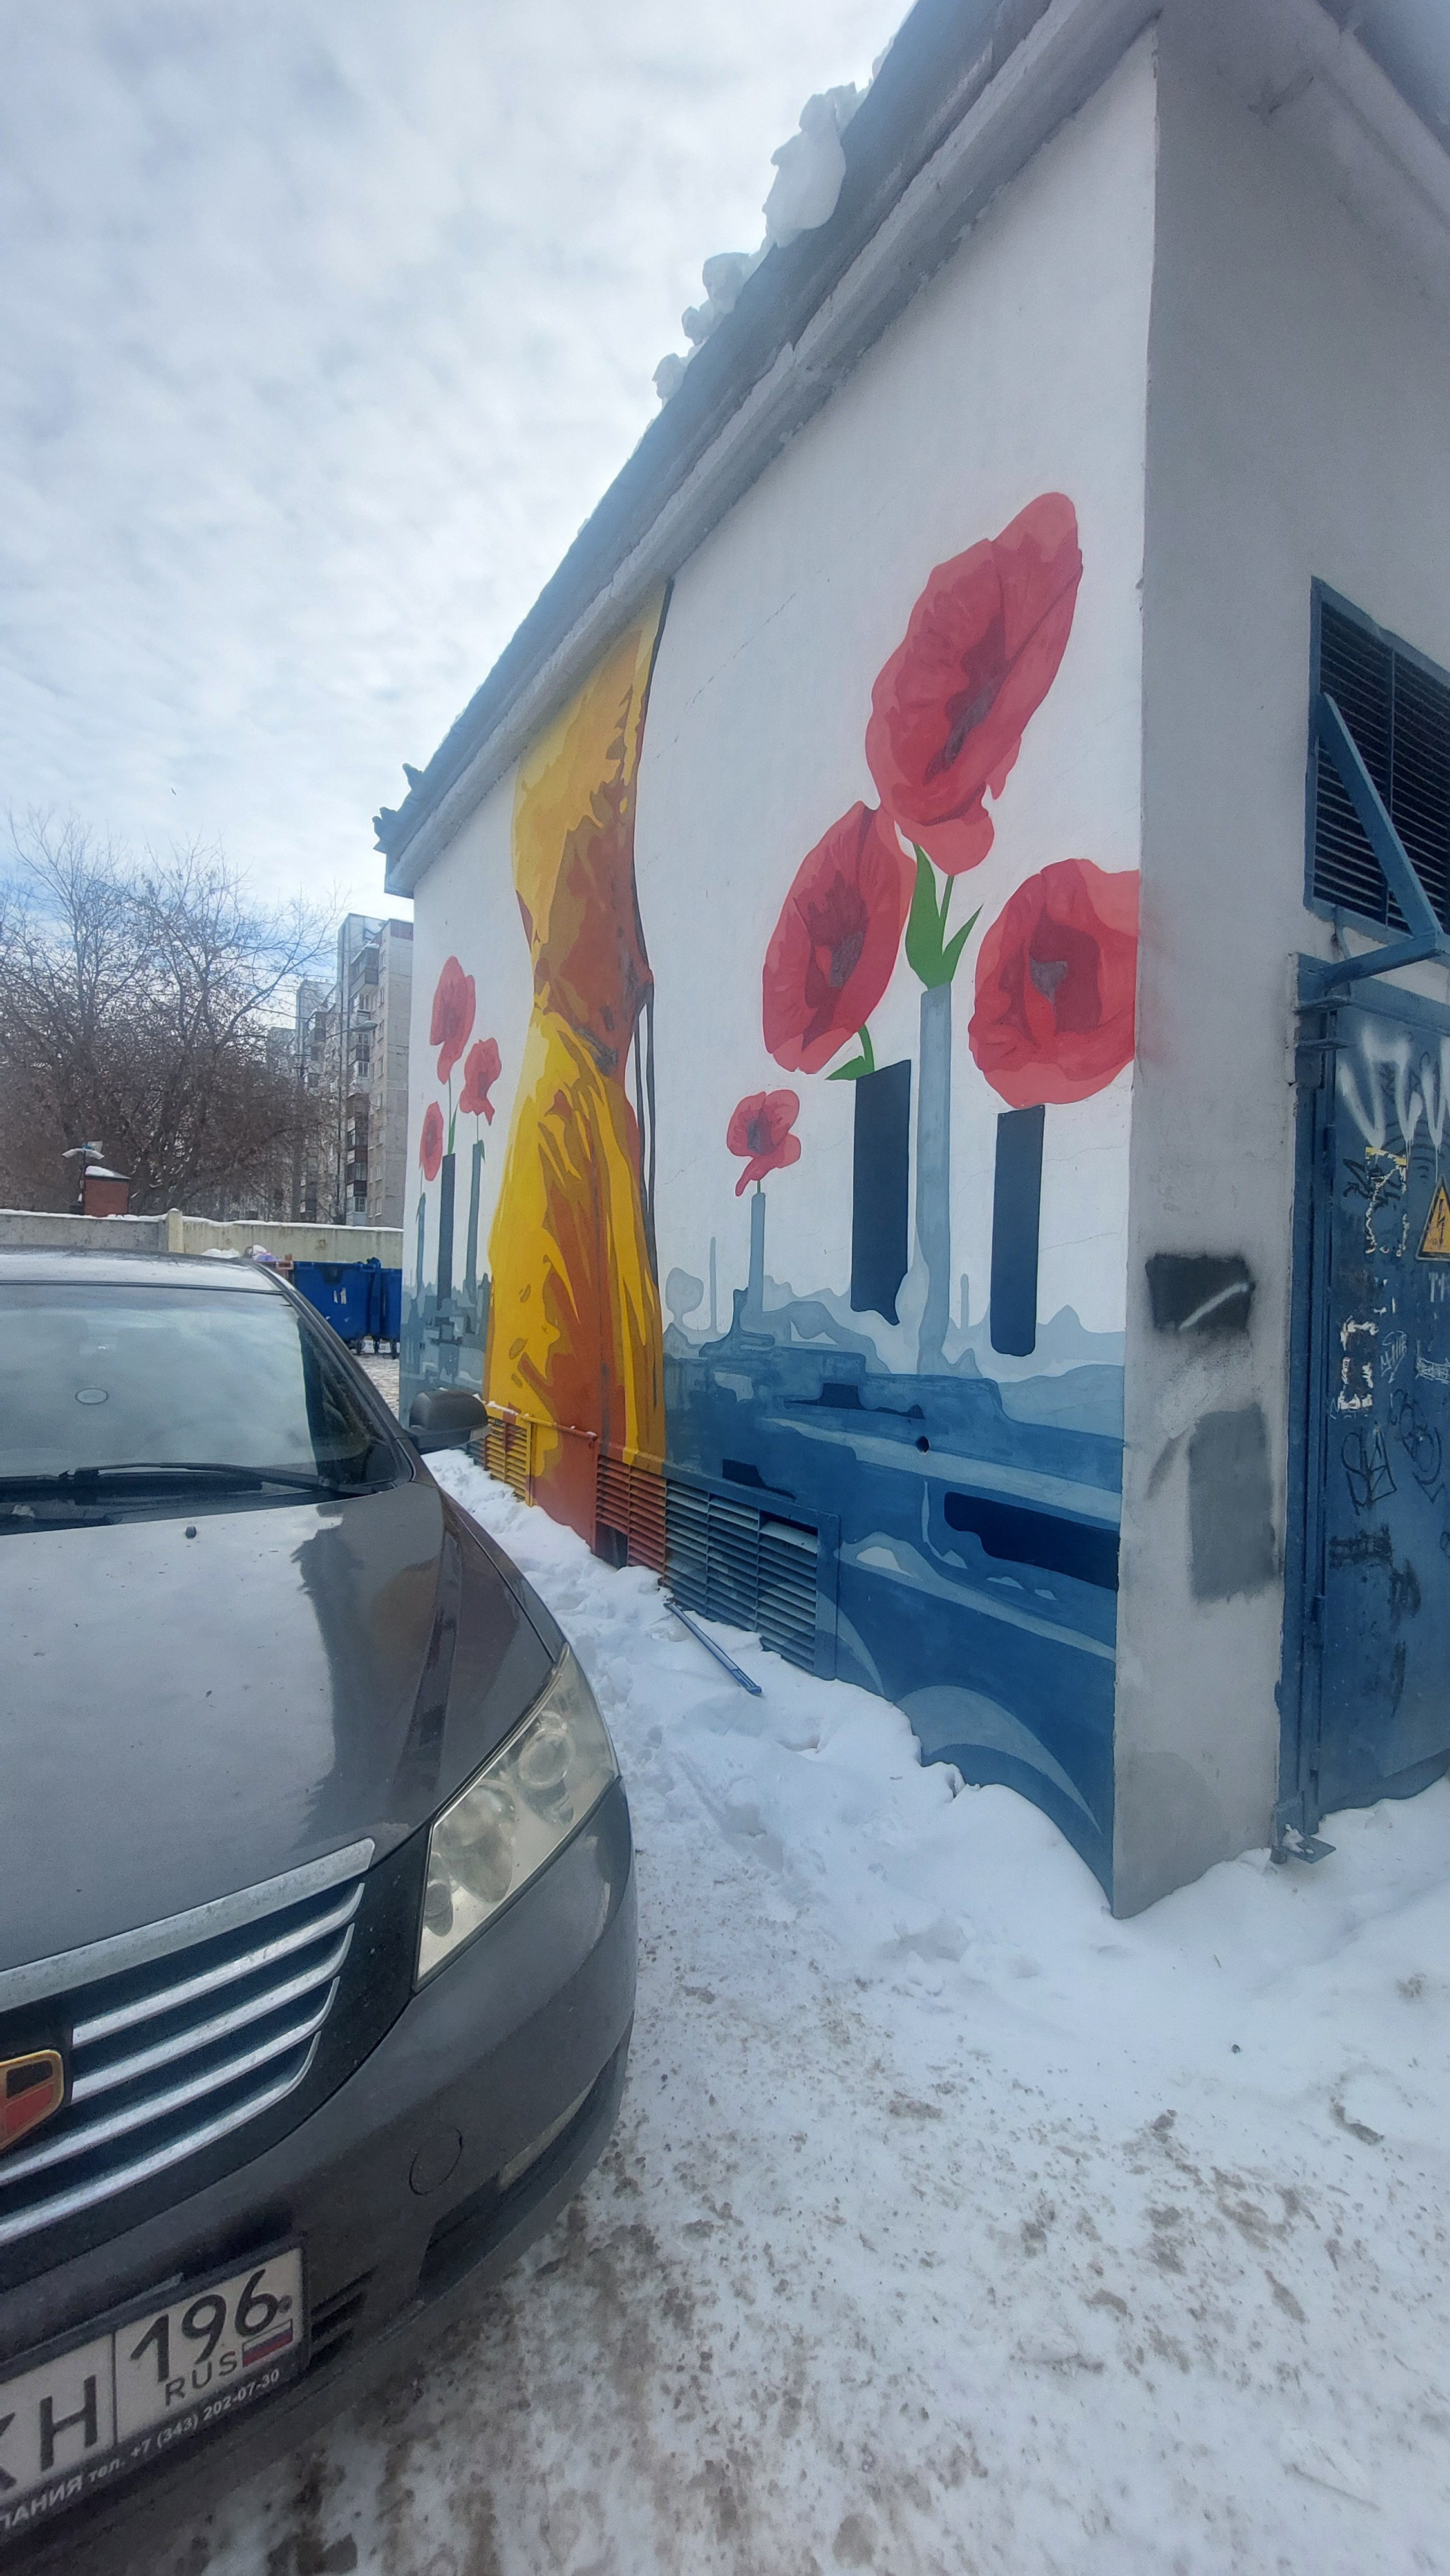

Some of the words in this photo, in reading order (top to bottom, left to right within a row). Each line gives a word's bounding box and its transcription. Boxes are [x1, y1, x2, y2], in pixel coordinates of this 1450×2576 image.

[129, 2268, 279, 2383] 196
[131, 2438, 152, 2458] +7
[156, 2412, 199, 2450] (343)
[203, 2368, 279, 2421] 202-07-30
[165, 2351, 238, 2407] RUS
